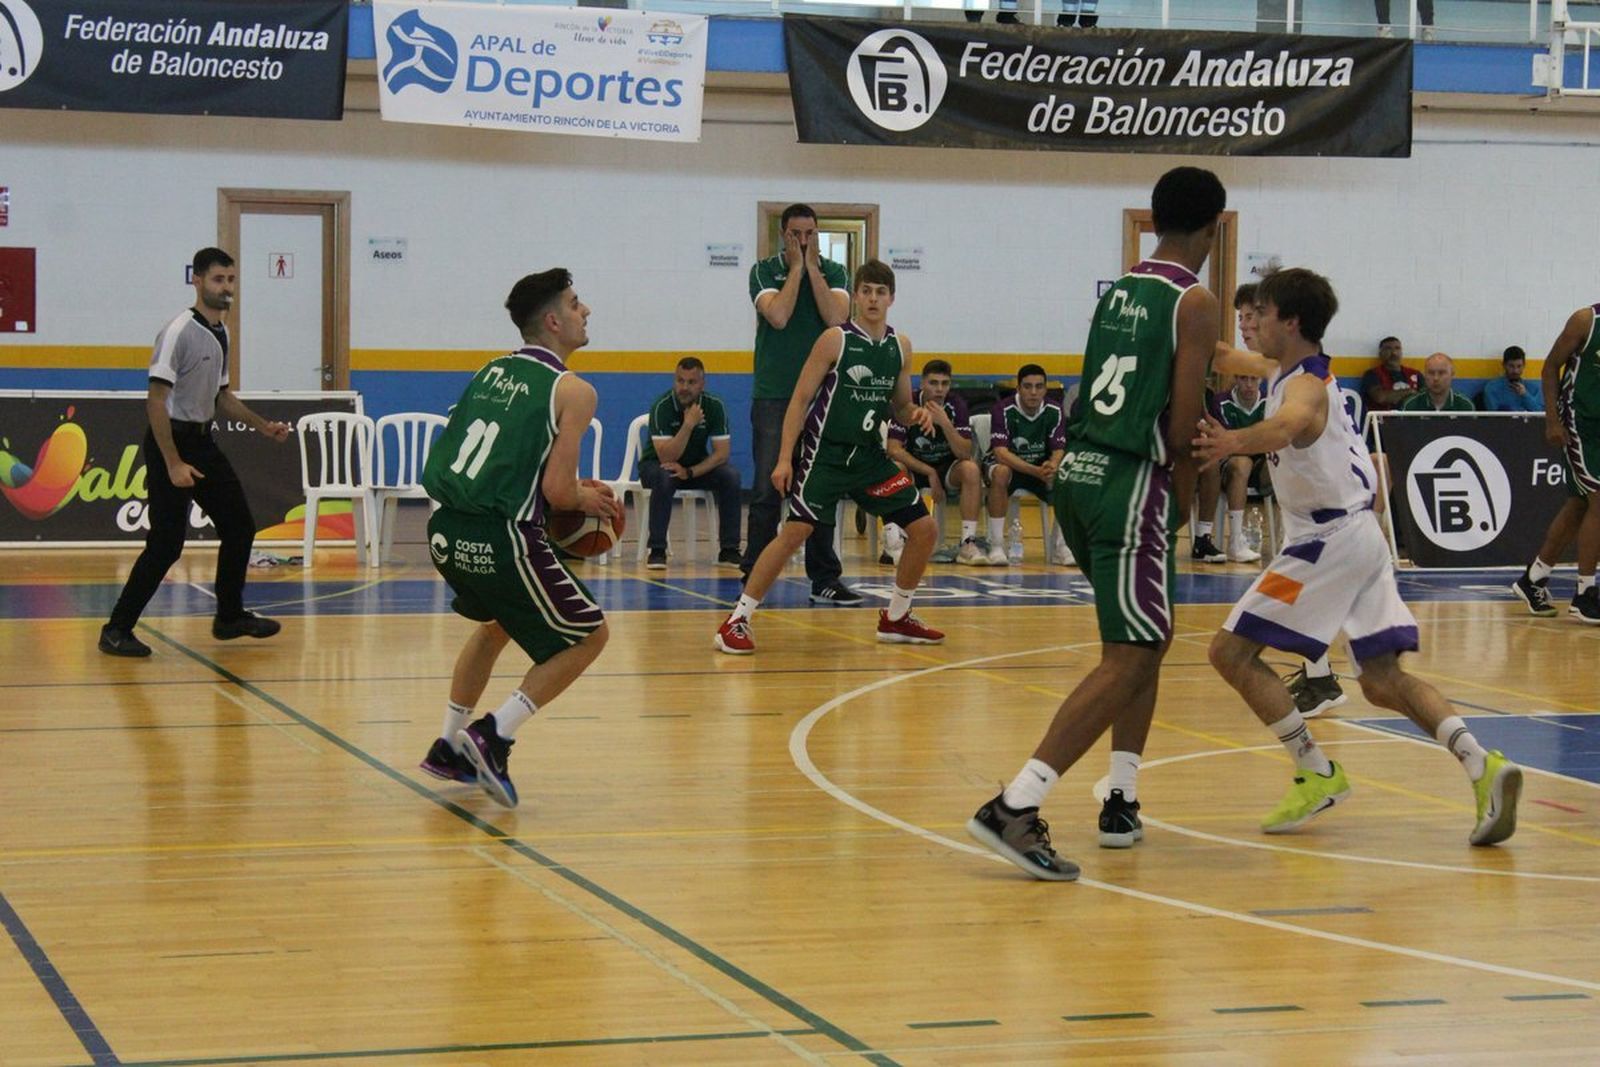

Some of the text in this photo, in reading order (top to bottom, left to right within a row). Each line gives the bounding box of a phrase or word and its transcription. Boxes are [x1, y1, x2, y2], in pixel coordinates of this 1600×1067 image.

[64, 14, 330, 51] Federación Andaluza
[470, 33, 557, 56] APAL de
[111, 49, 284, 81] de Baloncesto
[959, 41, 1354, 87] Federación Andaluza
[465, 55, 683, 108] Deportes
[464, 110, 681, 134] AYUNTAMIENTO RINCÓN DE LA VICTORIA
[1027, 94, 1286, 137] de Baloncesto
[373, 250, 403, 260] Aseos
[862, 408, 876, 431] 6
[450, 418, 500, 481] 11
[1532, 458, 1567, 486] Fe
[454, 551, 495, 565] DEL SOL
[455, 539, 494, 554] COSTA
